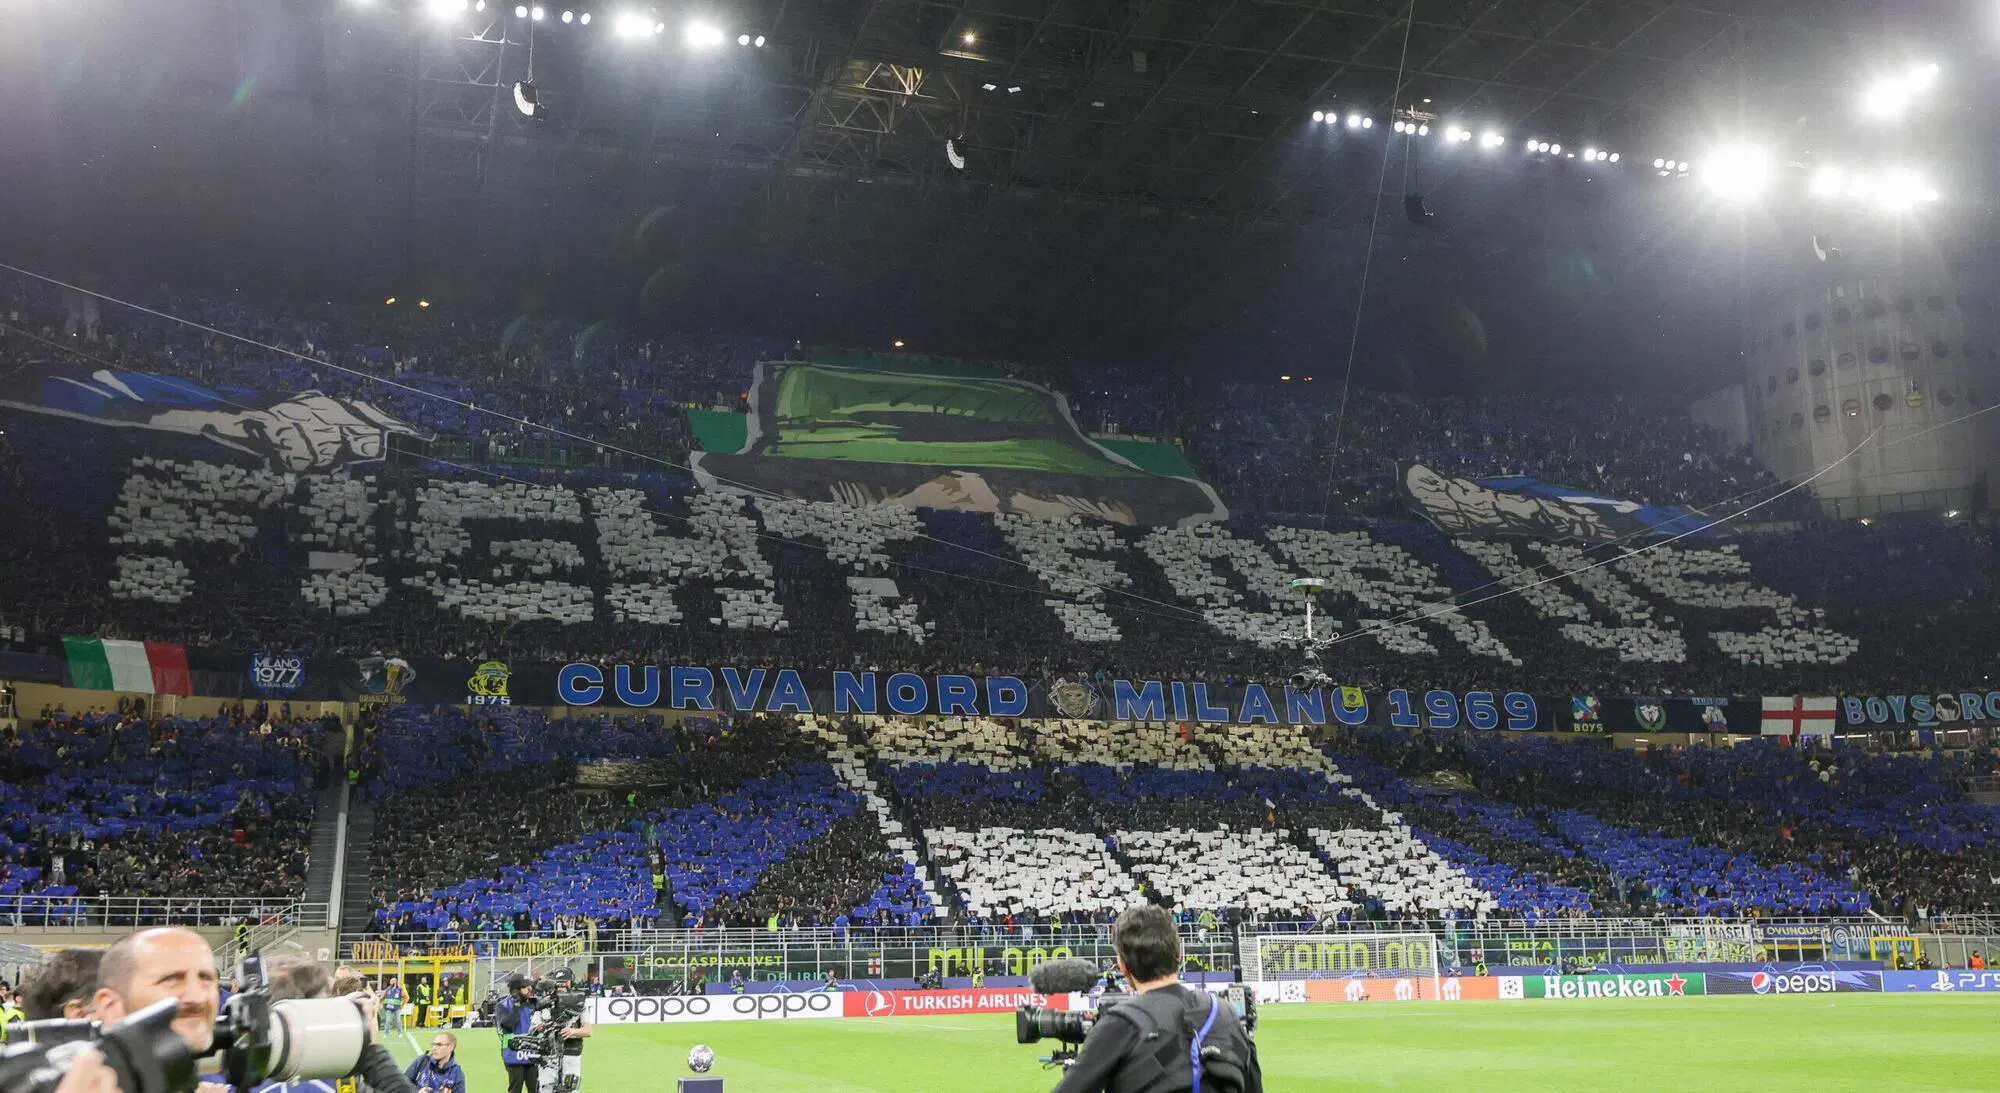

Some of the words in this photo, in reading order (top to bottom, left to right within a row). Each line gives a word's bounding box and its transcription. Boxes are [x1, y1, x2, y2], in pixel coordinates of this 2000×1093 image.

[254, 657, 300, 669] MILANO
[254, 667, 300, 684] 1977
[467, 694, 511, 705] 1975
[557, 662, 813, 712] CURVA
[833, 671, 1028, 716] NORD
[1113, 679, 1369, 725] MILANO
[1388, 689, 1538, 730] 1969
[1843, 693, 1934, 725] BOYS
[1573, 722, 1604, 733] BOYS
[1766, 925, 1820, 936] OVUNQUE
[352, 941, 399, 961] RIVIERA
[500, 942, 545, 957] MONTALTO
[1543, 974, 1664, 999] Heineken
[1775, 971, 1837, 994] pepsi
[608, 996, 710, 1022] oppo
[732, 993, 831, 1018] oppo
[902, 994, 973, 1010] TURKISH
[978, 991, 1048, 1008] AIRLINES
